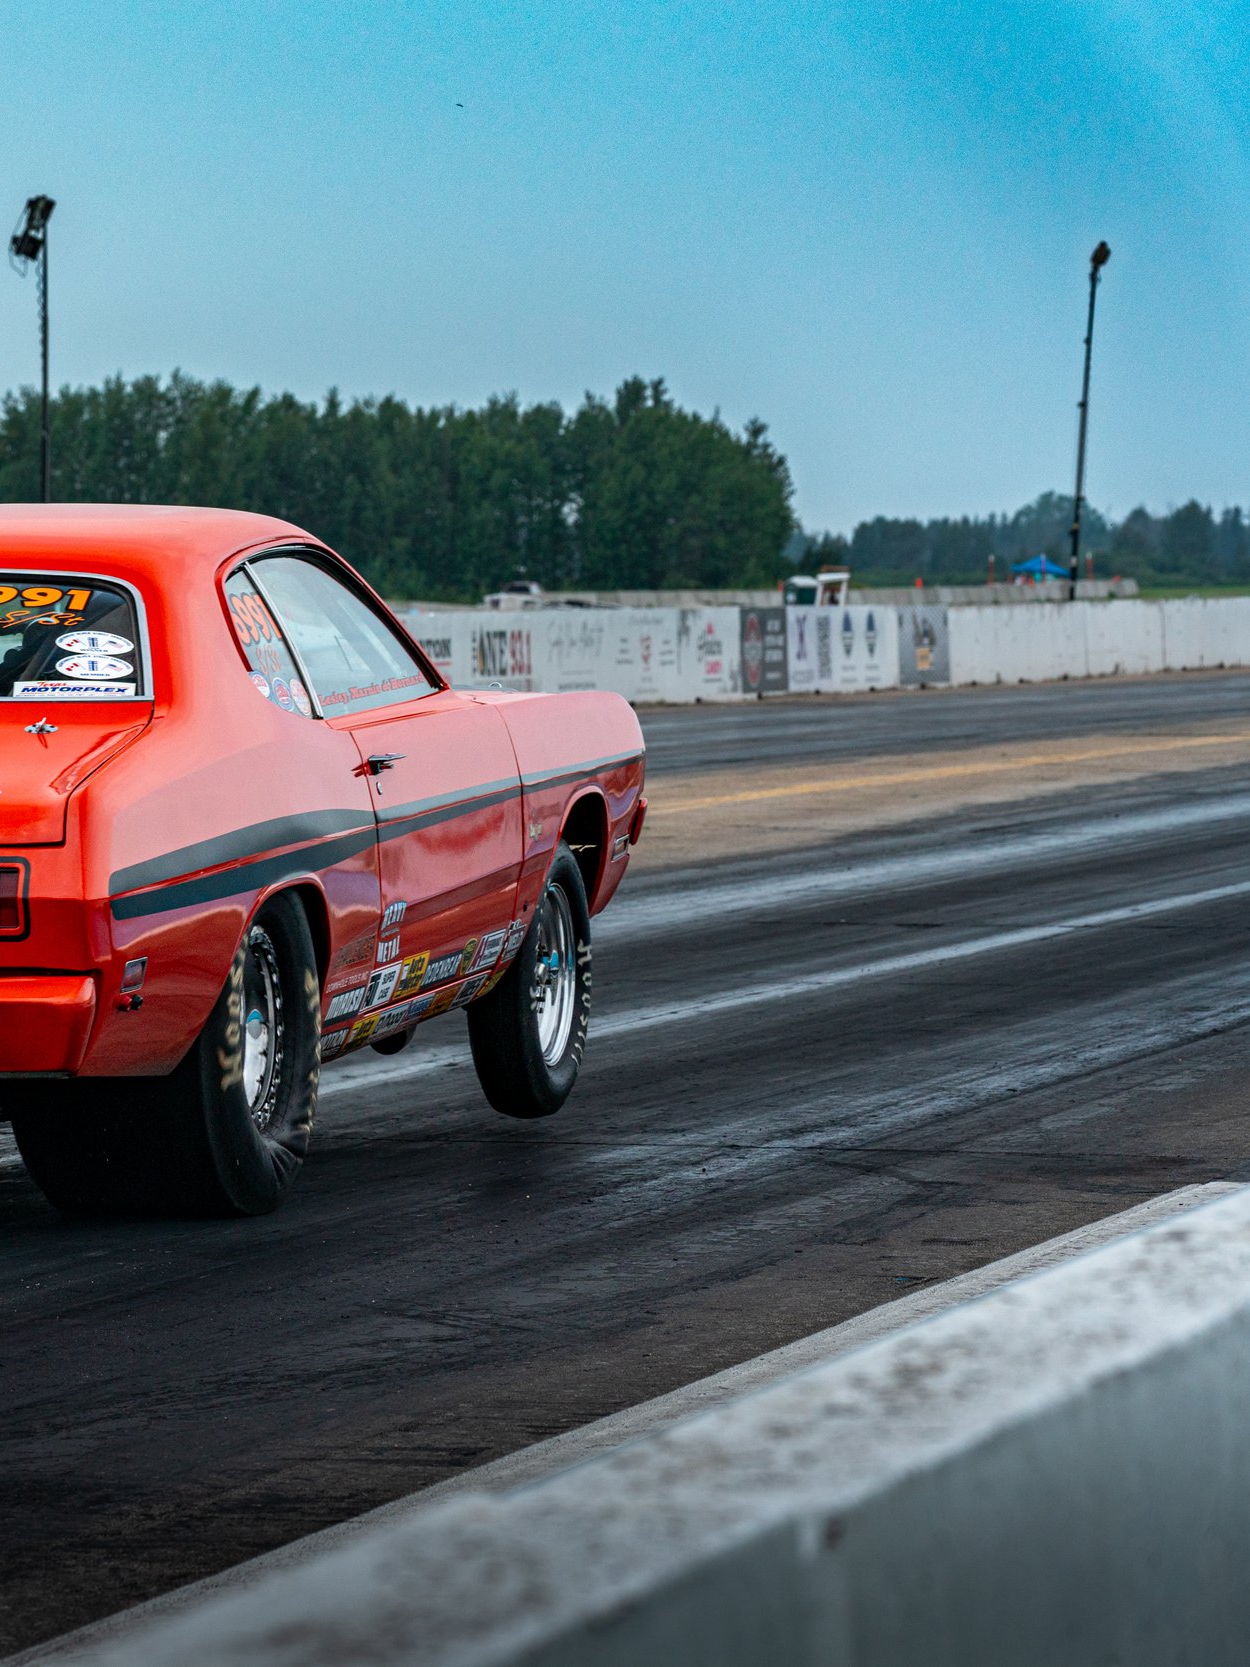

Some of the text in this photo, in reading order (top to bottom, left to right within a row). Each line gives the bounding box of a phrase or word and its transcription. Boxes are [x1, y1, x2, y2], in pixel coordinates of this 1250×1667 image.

[351, 683, 381, 701] Marnie
[382, 680, 390, 692] &
[377, 936, 400, 963] METAL
